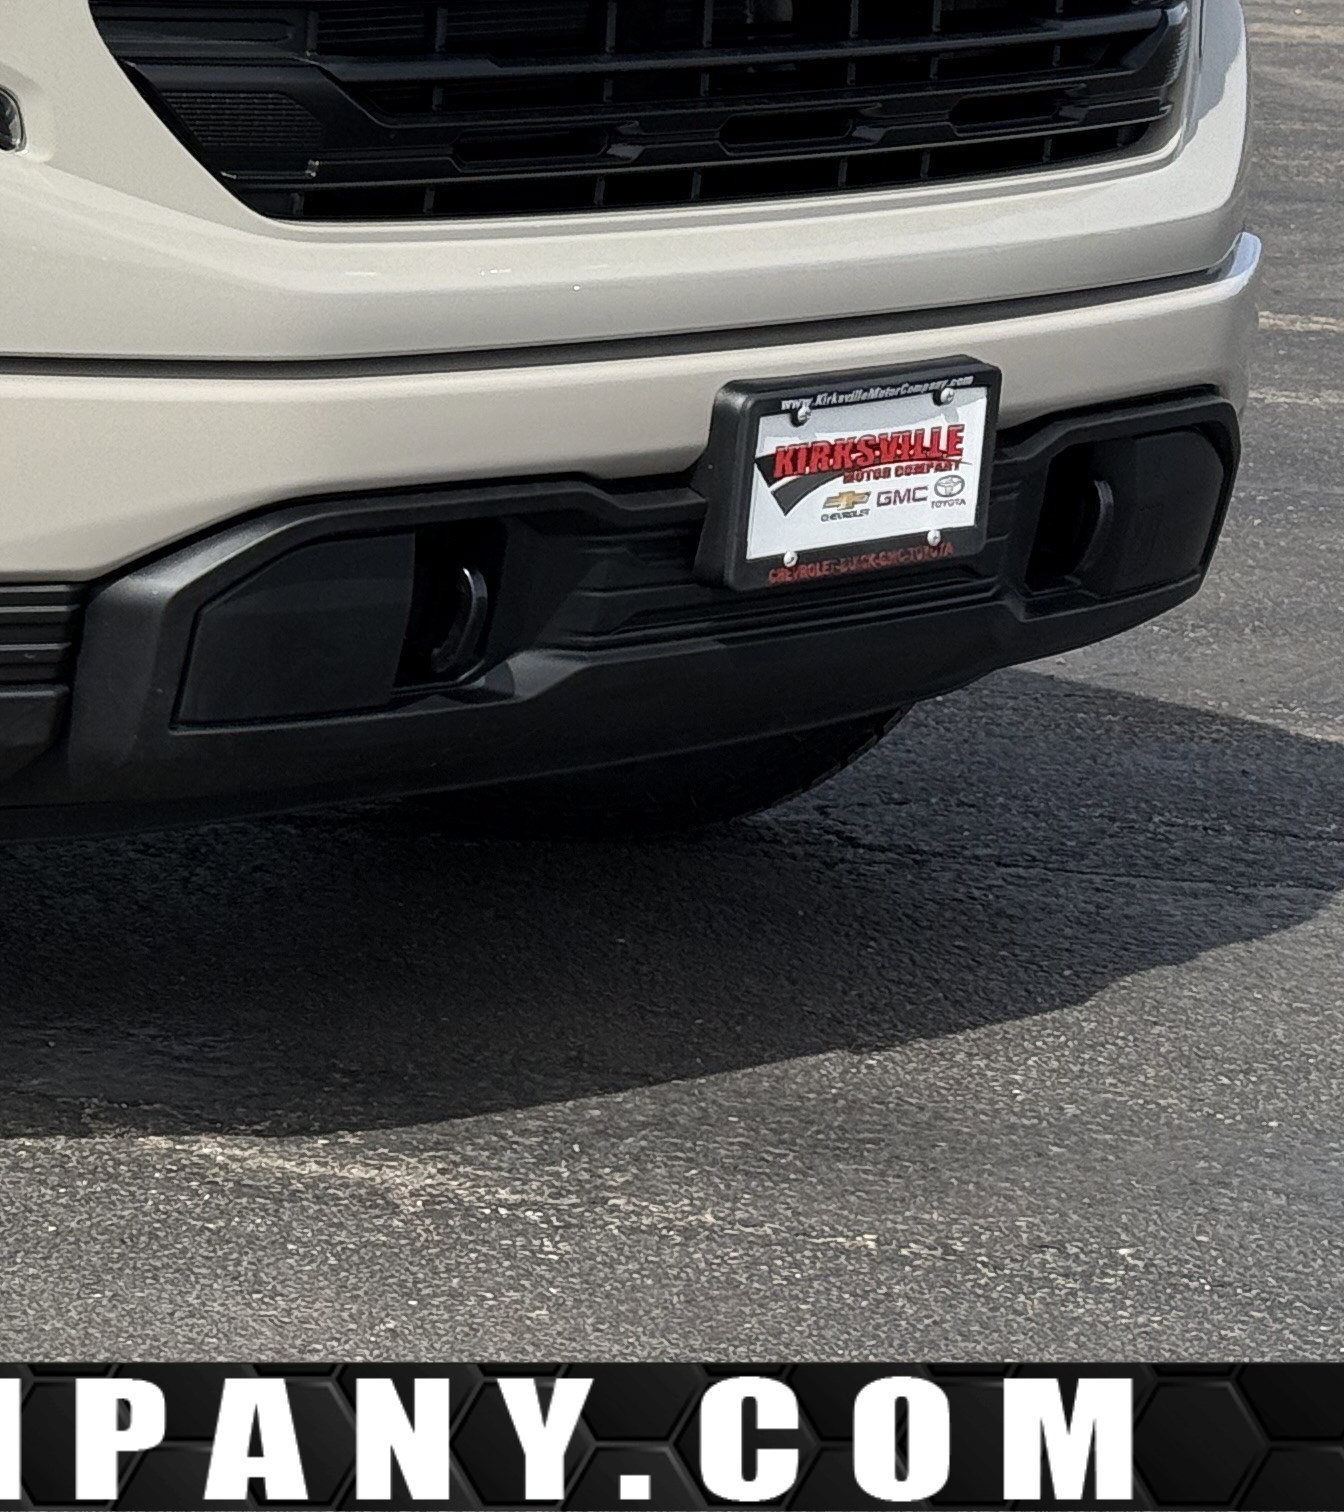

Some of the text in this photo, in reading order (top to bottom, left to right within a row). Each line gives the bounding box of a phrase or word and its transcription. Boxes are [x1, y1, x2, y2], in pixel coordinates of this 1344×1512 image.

[773, 424, 965, 479] KIRKSVILLE
[843, 459, 962, 484] MOTOR COMPANY
[876, 486, 929, 507] GMC
